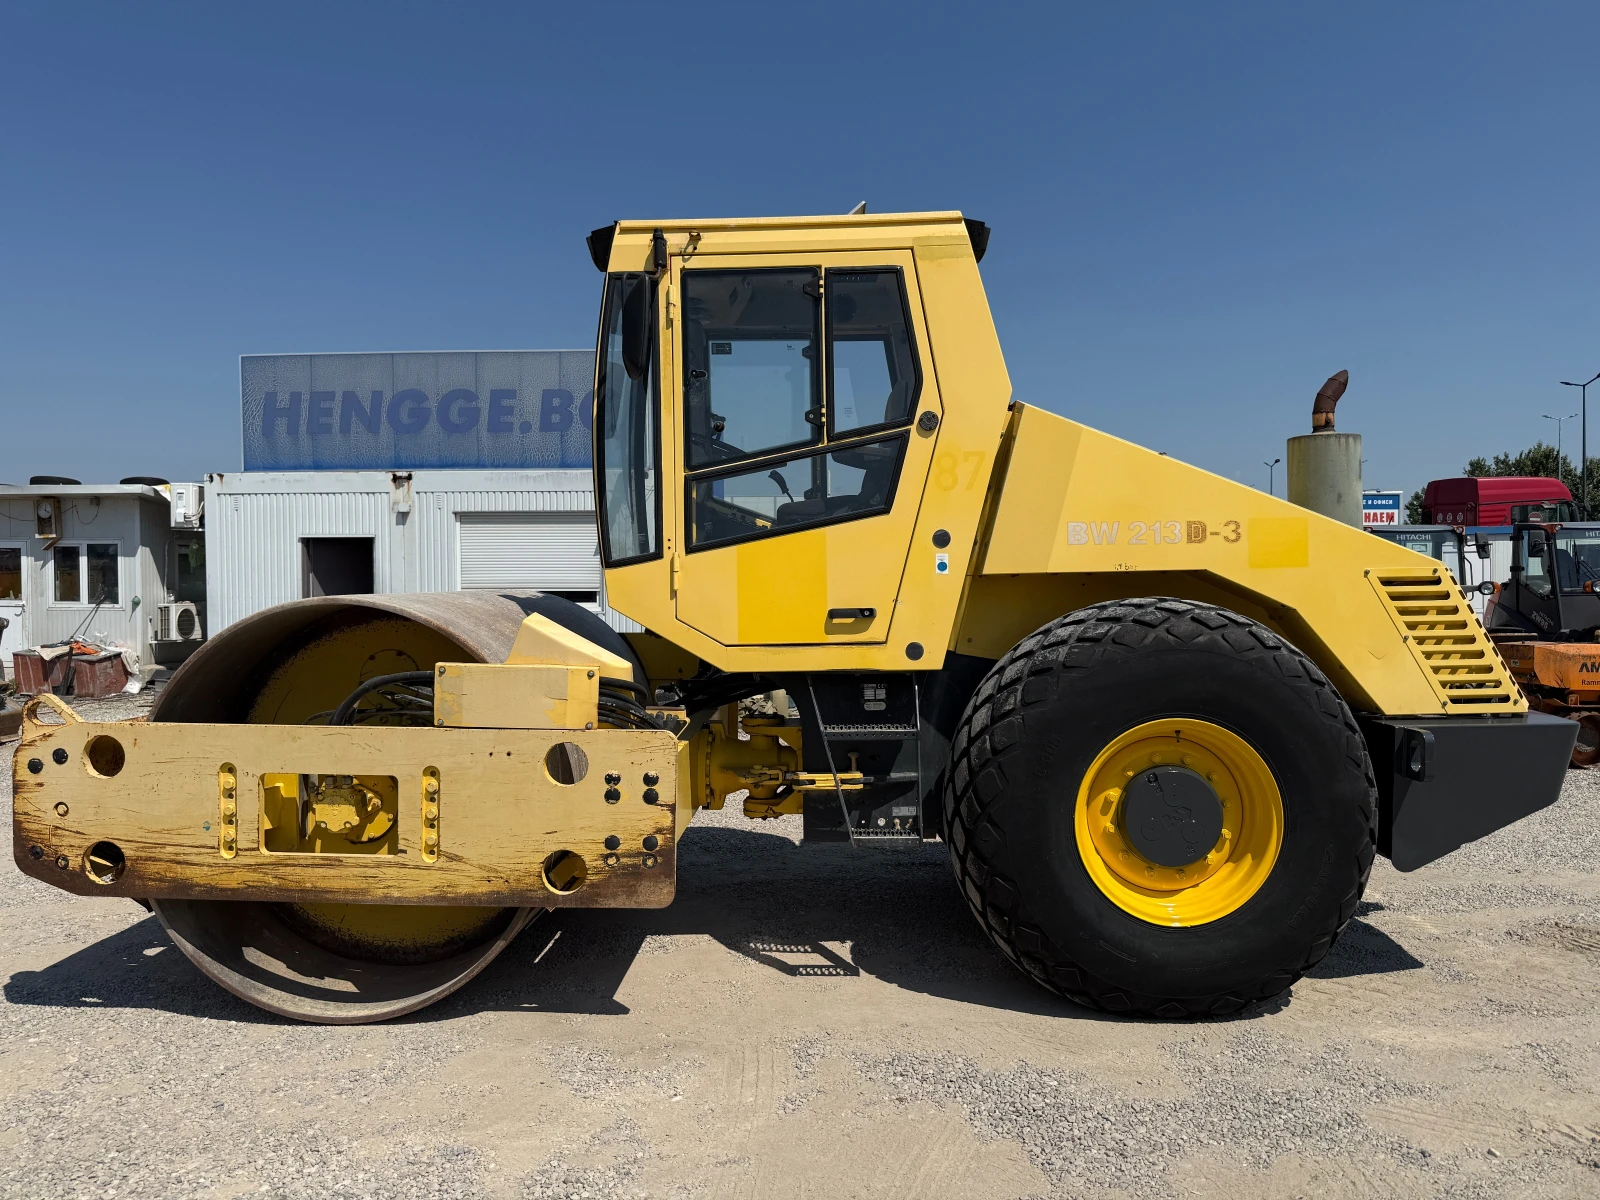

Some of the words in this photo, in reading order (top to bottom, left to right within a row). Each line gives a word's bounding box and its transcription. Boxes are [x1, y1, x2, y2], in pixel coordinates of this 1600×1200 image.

[934, 450, 986, 491] 87
[1363, 511, 1395, 523] НАЕМ
[1067, 520, 1121, 545] BW
[1585, 530, 1600, 538] HIT
